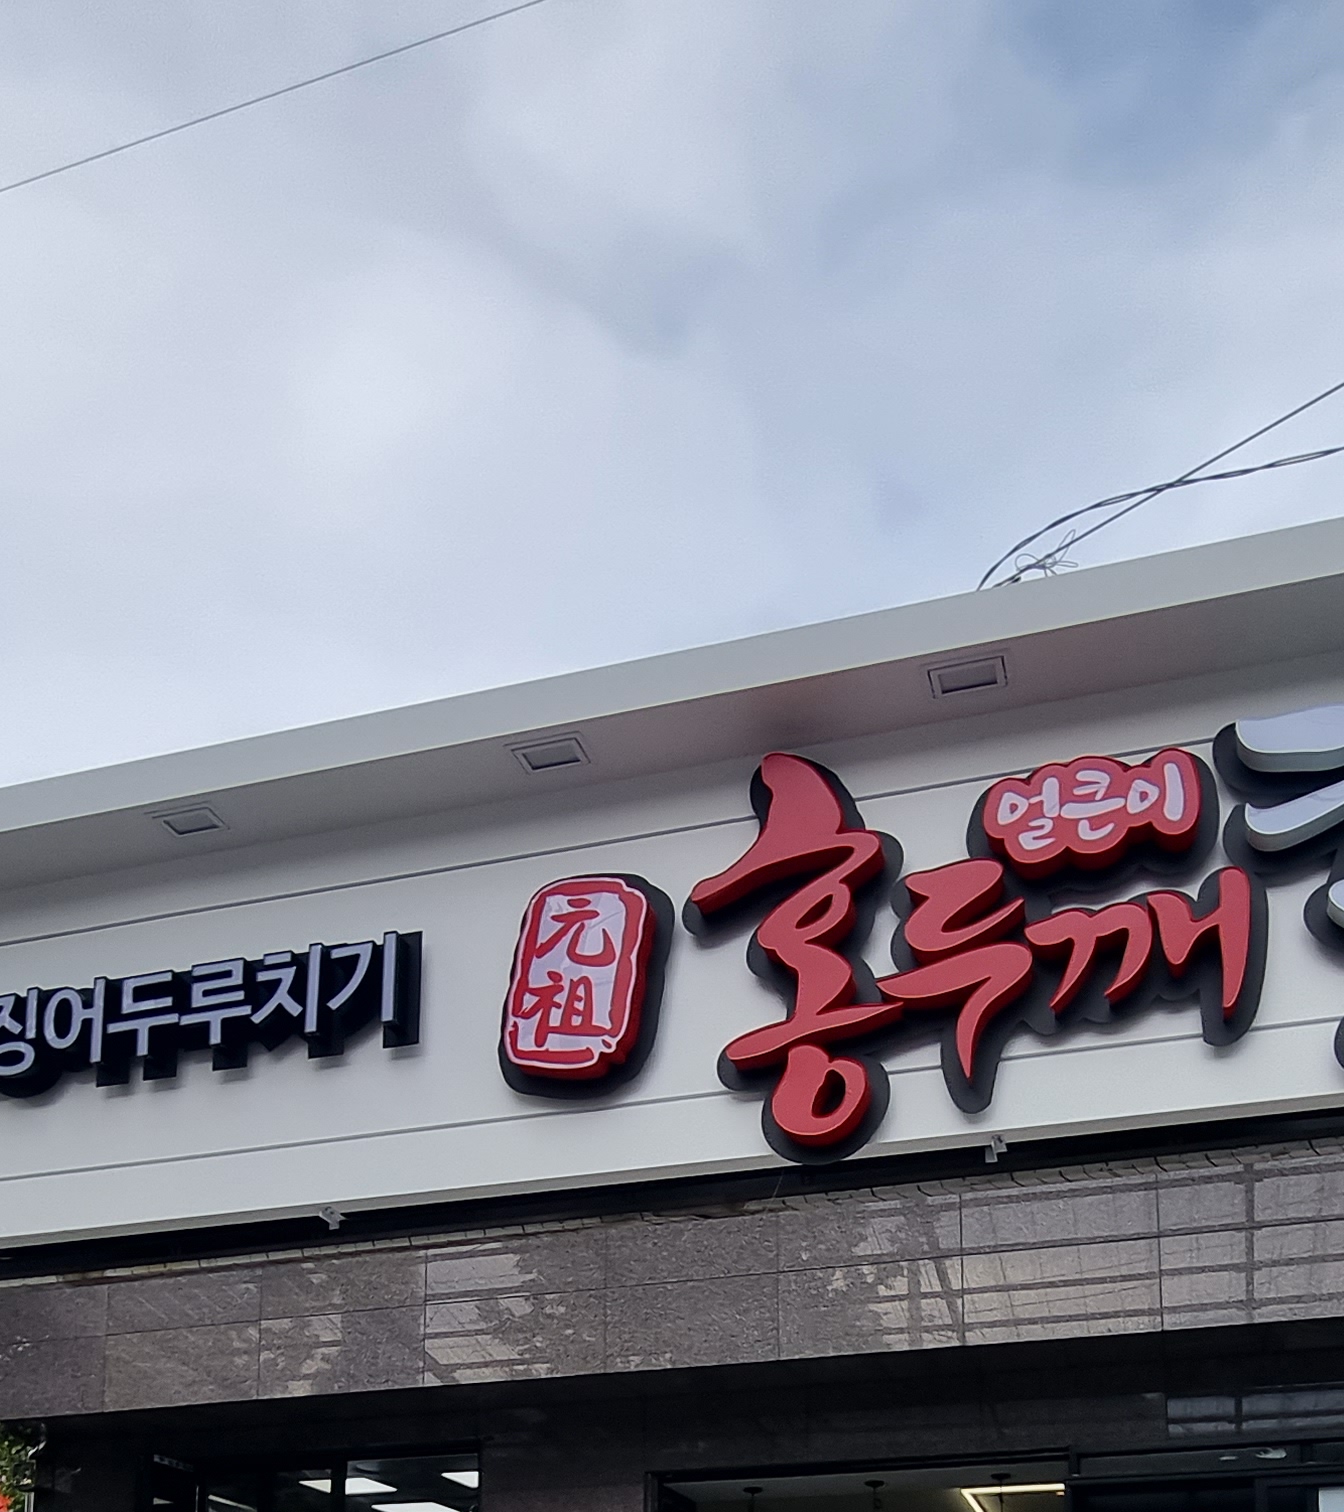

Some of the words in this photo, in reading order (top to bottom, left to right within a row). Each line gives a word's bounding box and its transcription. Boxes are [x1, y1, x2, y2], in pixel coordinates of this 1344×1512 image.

[996, 761, 1185, 851] 얼큰이
[513, 893, 617, 1050] 元祖
[691, 751, 1252, 1147] 홍두깨
